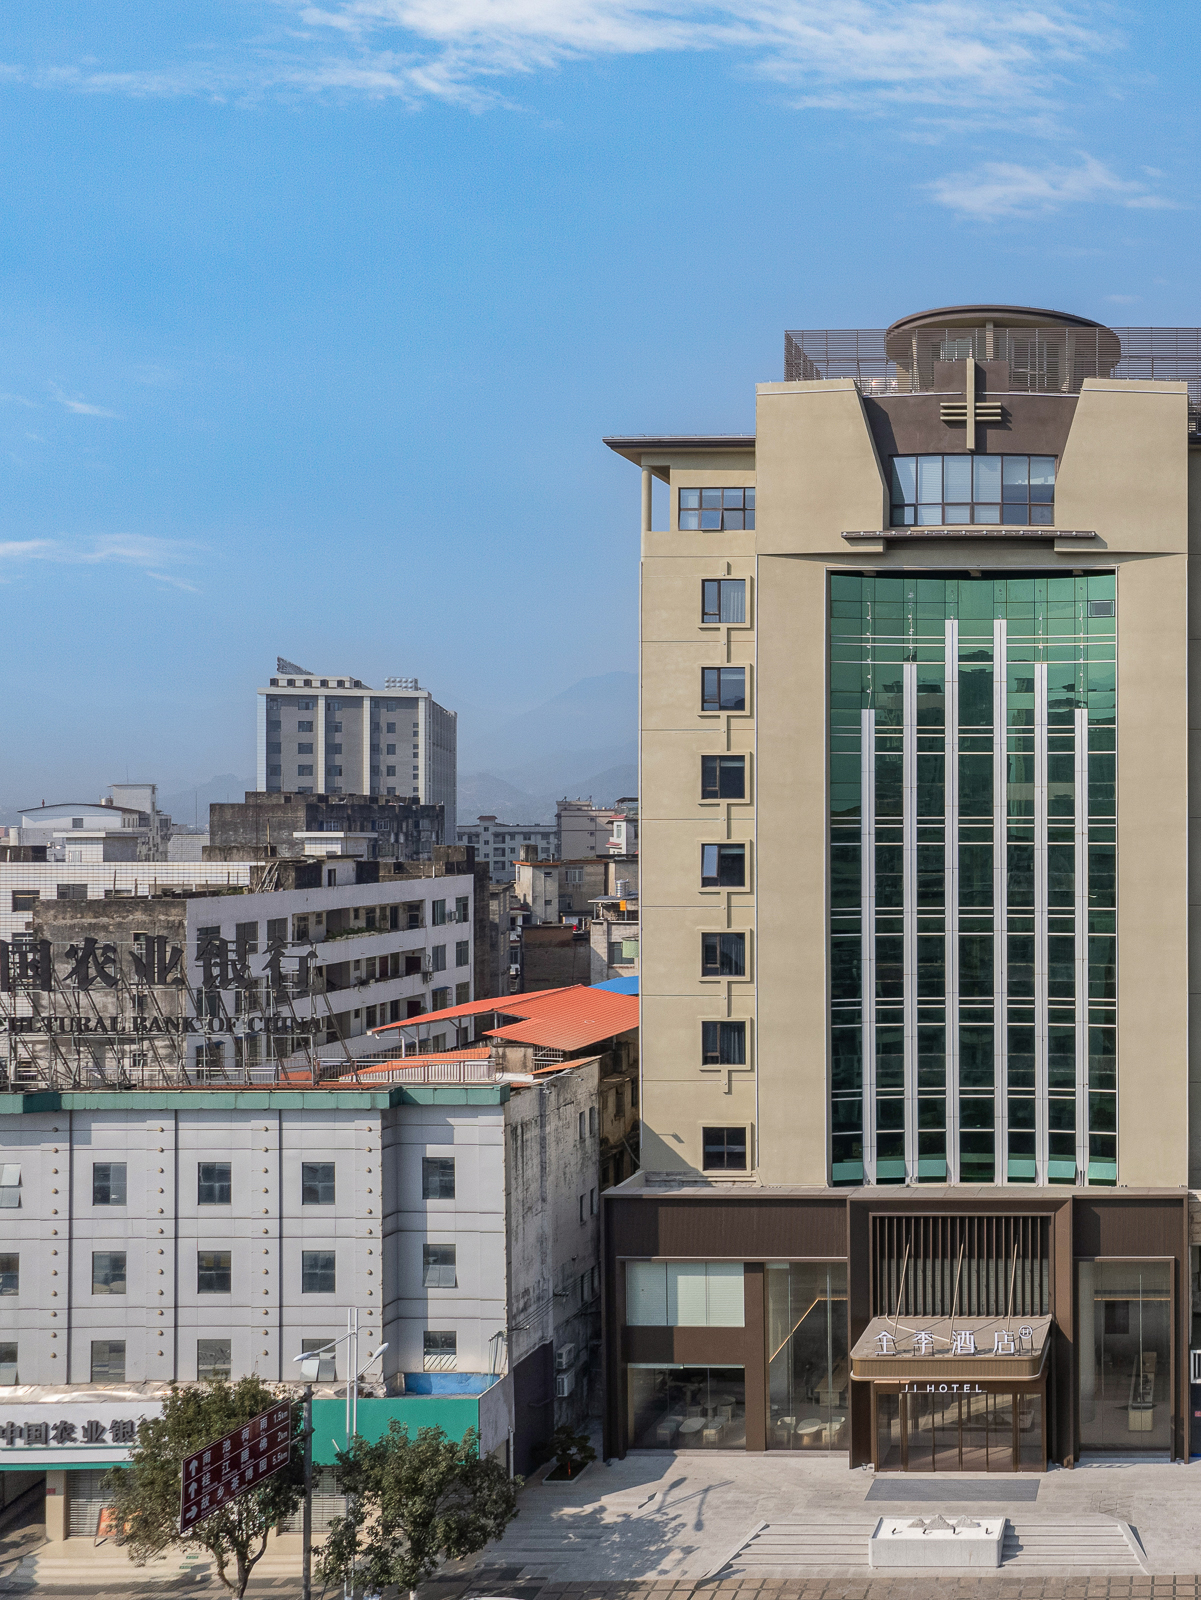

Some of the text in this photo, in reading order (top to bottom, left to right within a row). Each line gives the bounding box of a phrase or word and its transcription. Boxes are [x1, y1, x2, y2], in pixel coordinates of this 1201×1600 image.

[0, 935, 319, 992] 国农业银行
[132, 1016, 201, 1033] BANK
[207, 1016, 241, 1033] OF
[248, 1016, 322, 1033] CHINA
[873, 1329, 1015, 1355] 全季酒店
[904, 1383, 983, 1393] JI HOTEL
[0, 1419, 147, 1446] 中国农业银
